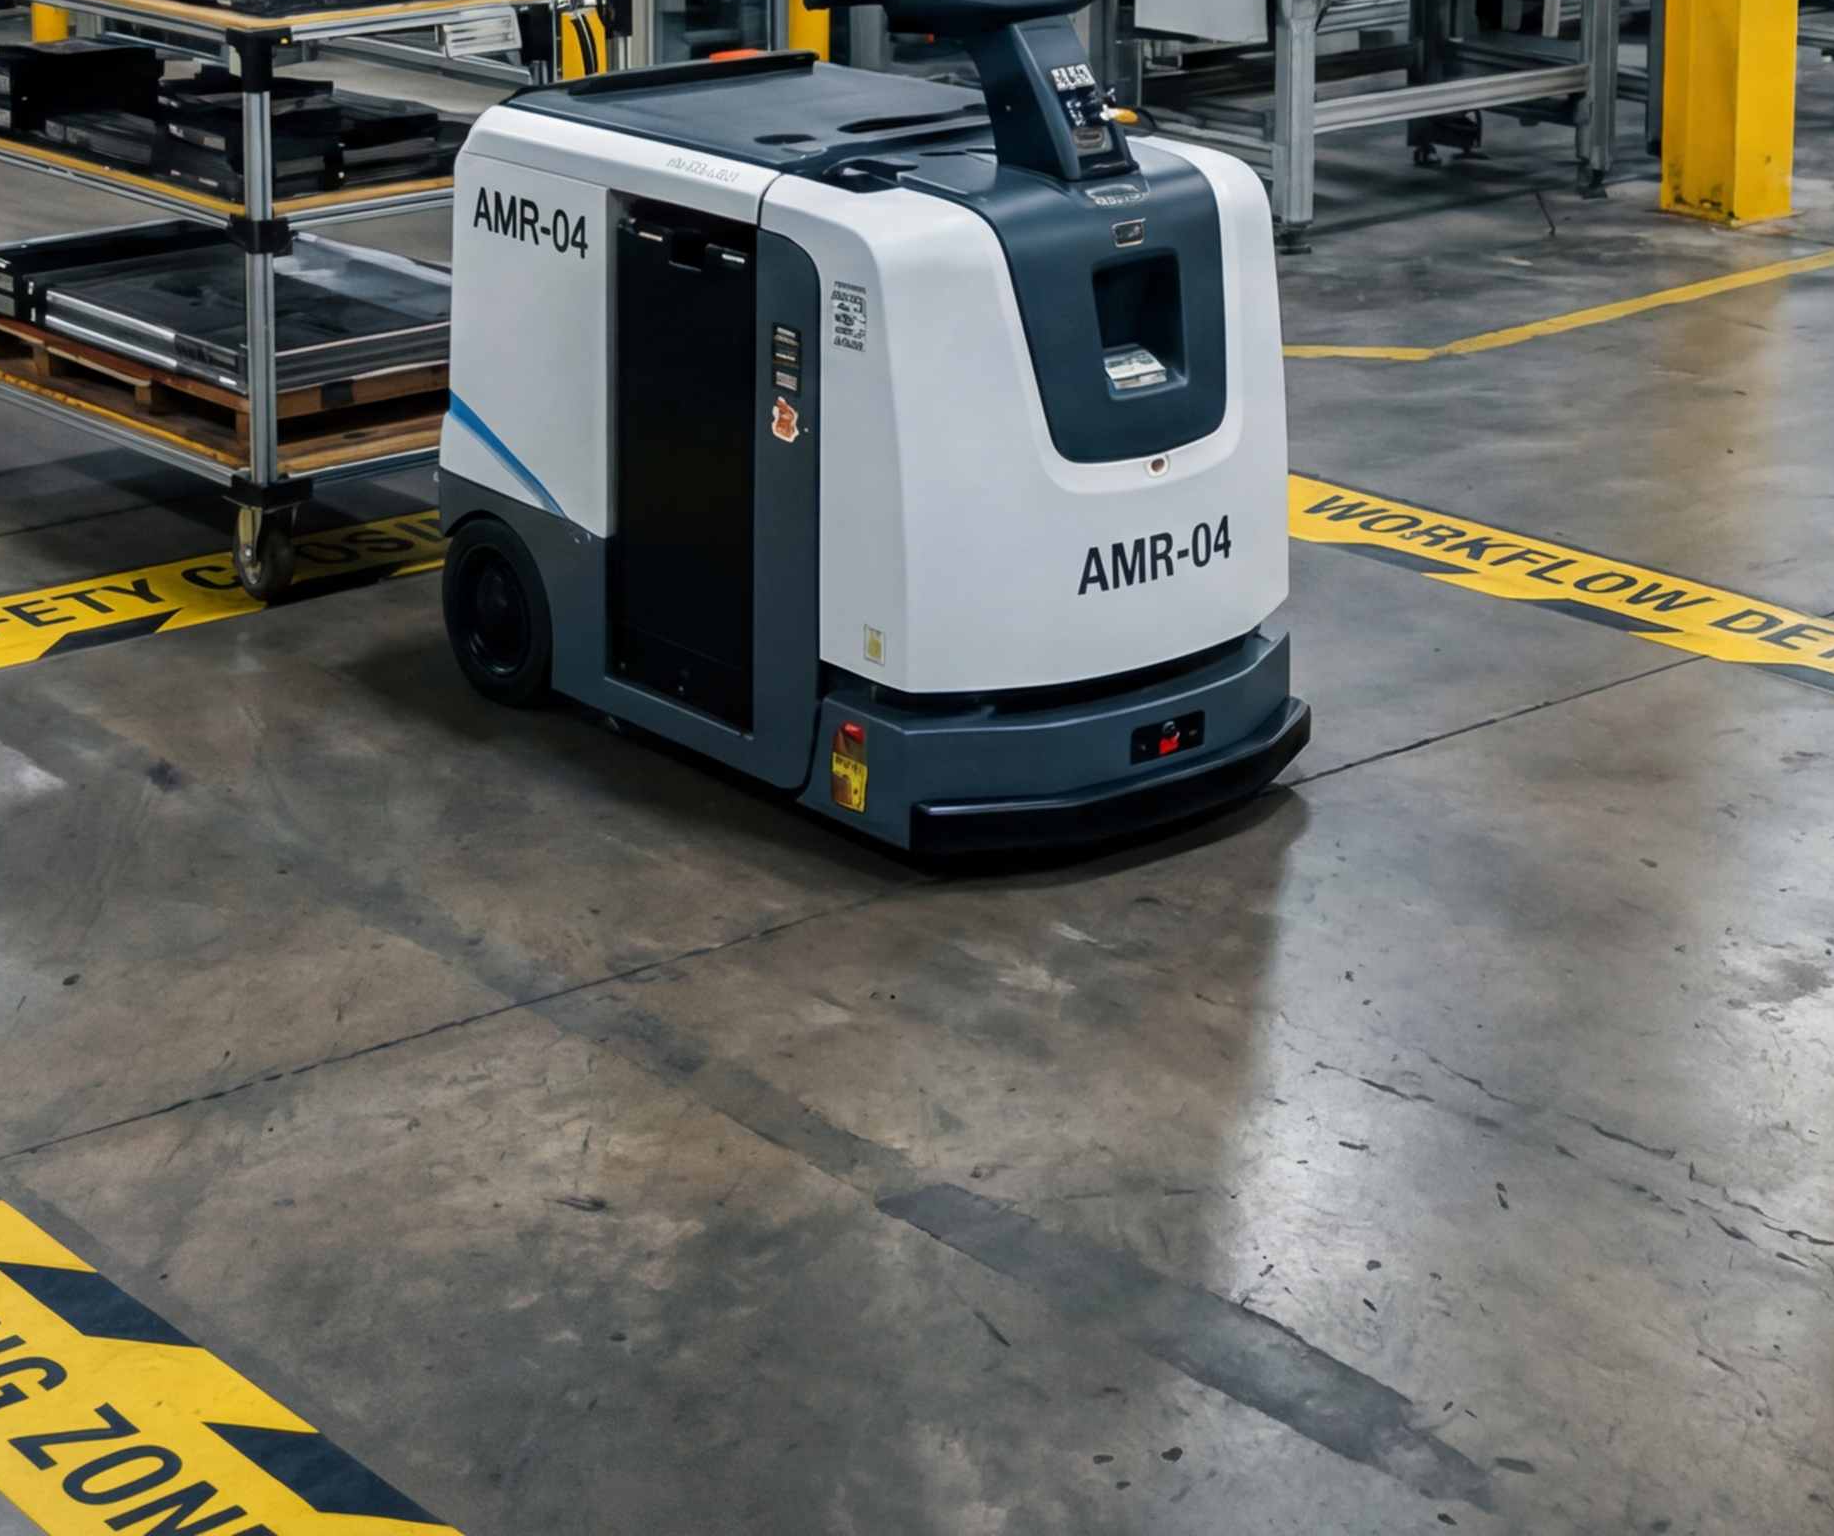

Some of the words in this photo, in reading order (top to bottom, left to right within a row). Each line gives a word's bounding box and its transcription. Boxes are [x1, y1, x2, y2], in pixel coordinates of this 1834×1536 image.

[474, 187, 588, 259] AMR-04
[1078, 516, 1231, 595] AMR-04
[1303, 494, 1715, 612] WORKFLOW
[9, 1403, 277, 1536] ZON
